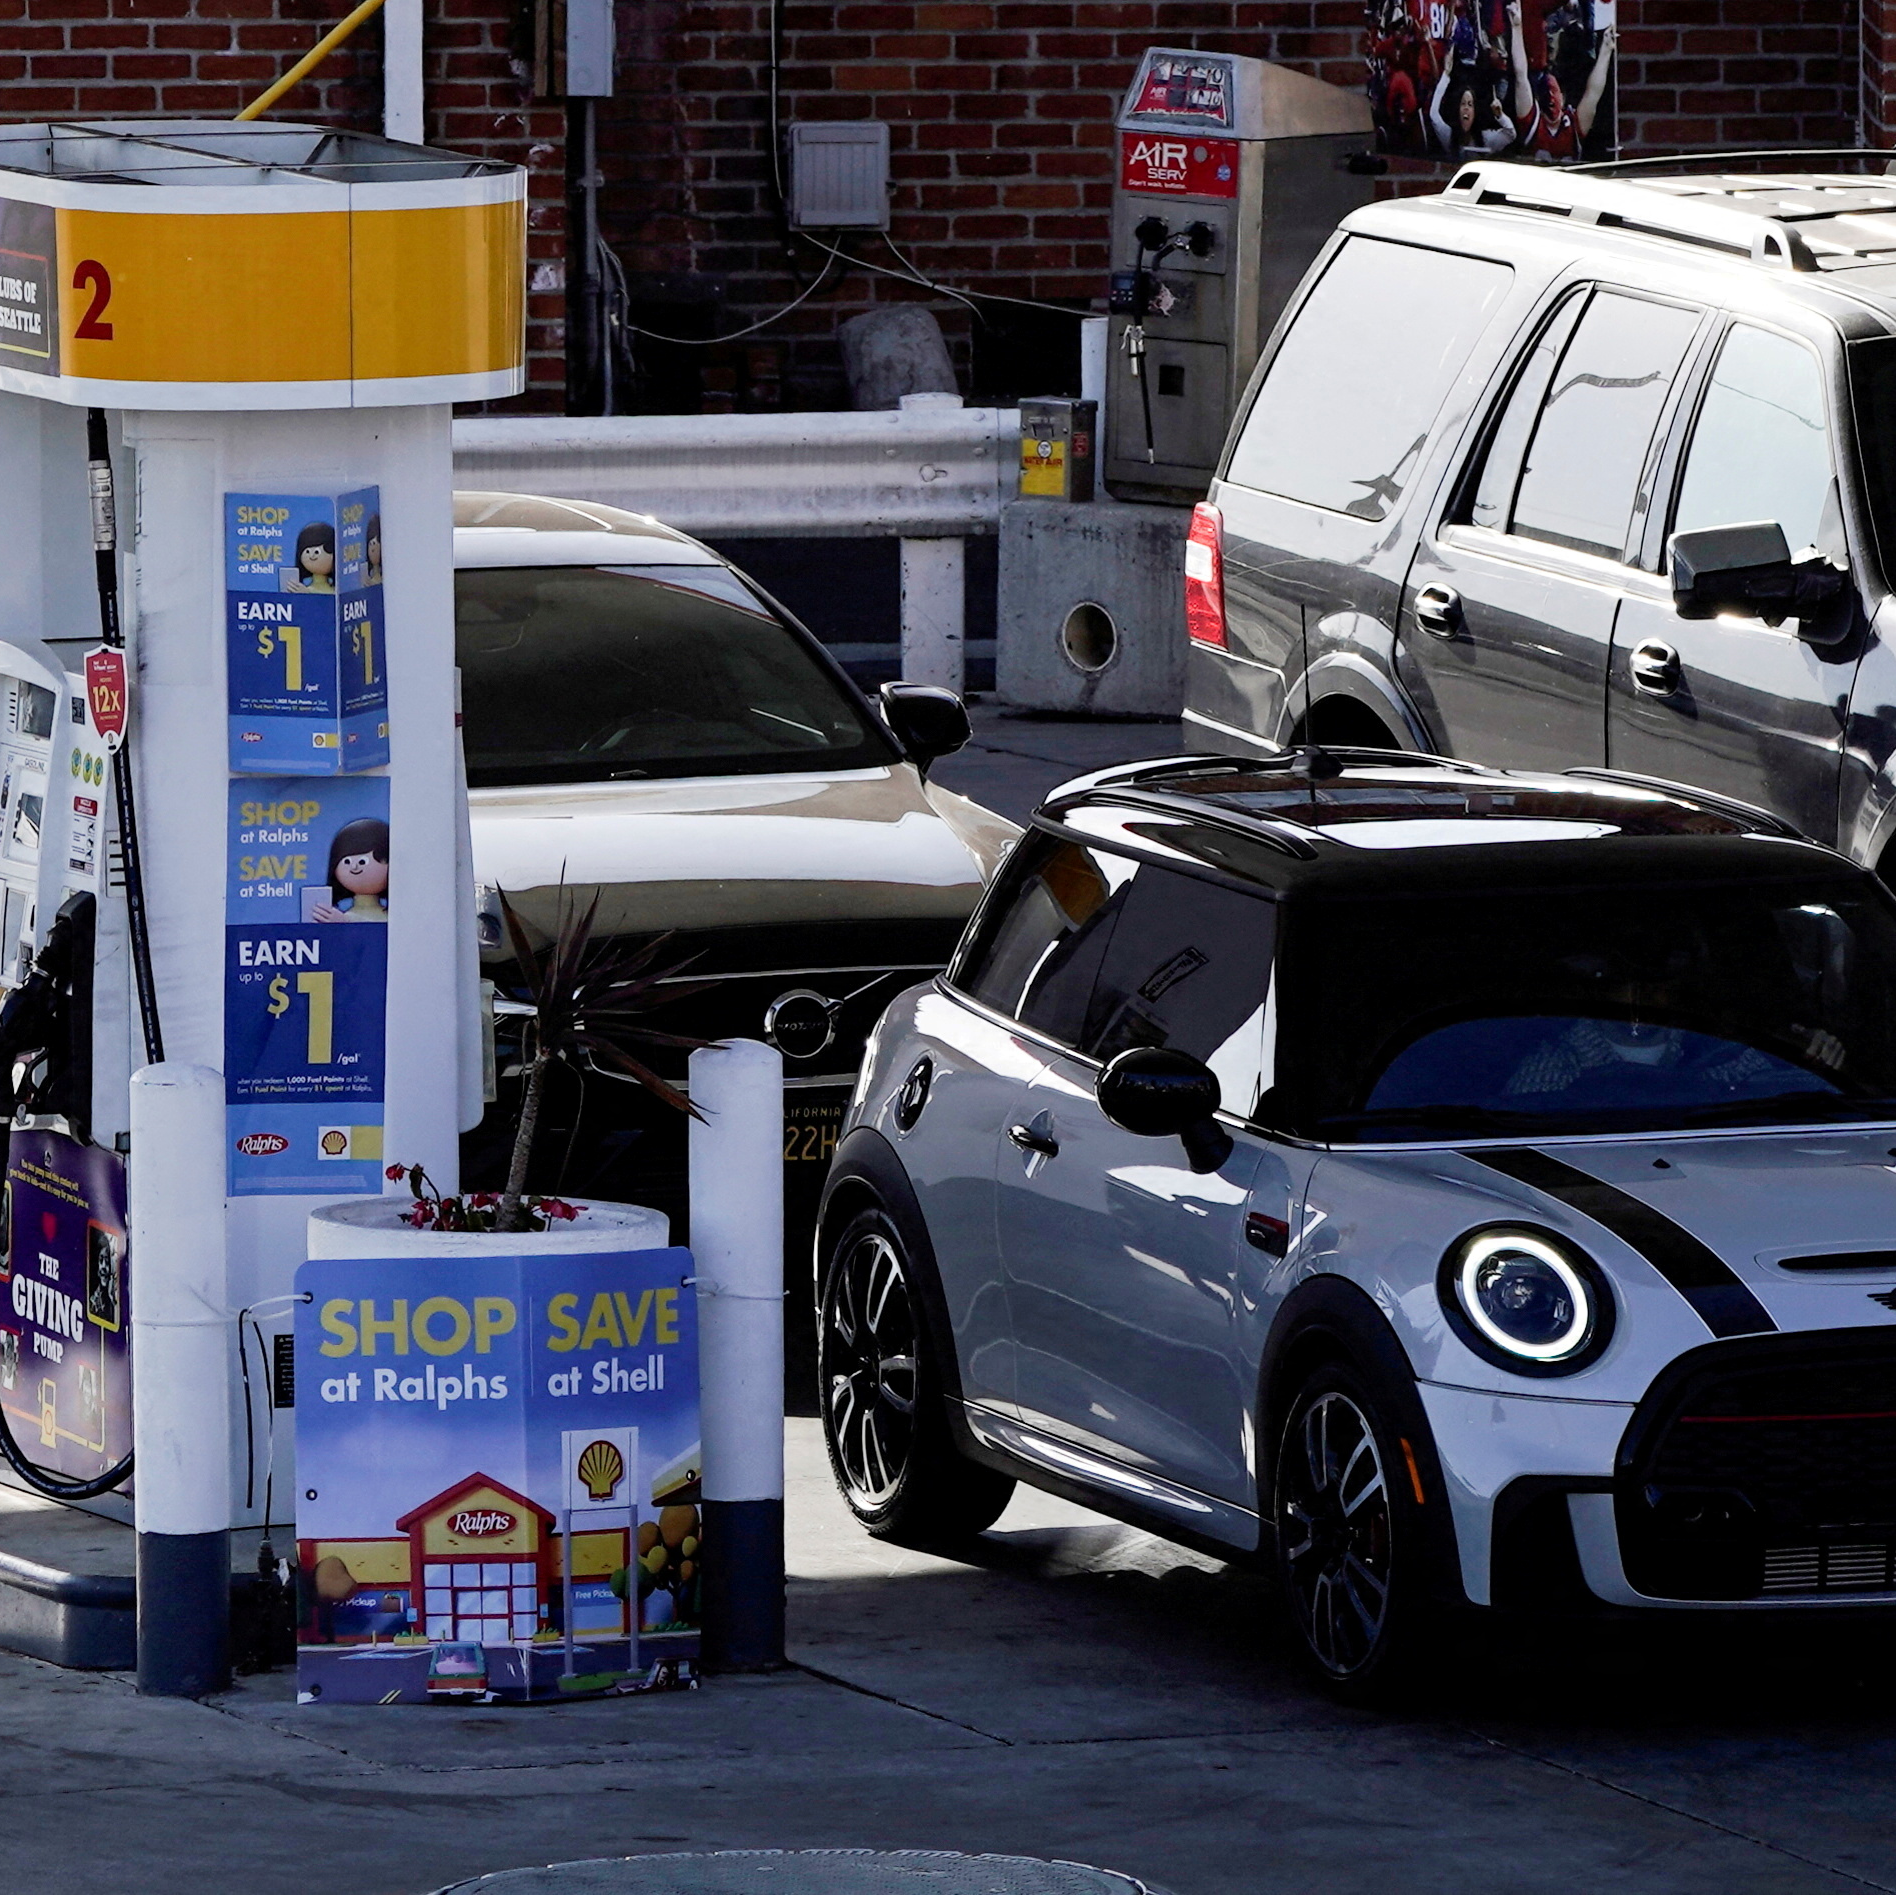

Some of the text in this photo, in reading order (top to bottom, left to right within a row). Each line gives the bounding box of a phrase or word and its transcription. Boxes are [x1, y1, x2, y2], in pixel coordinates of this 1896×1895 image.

[1128, 140, 1188, 170] AIR
[1148, 167, 1187, 181] SERV
[23, 282, 37, 304] OF
[72, 259, 114, 341] 2
[237, 506, 290, 525] SHOP
[237, 526, 283, 539] at Ralphs
[237, 544, 283, 562] SAVE
[238, 563, 274, 574] at Shell
[237, 601, 292, 622] EARN
[343, 600, 367, 622] EARN
[257, 625, 302, 691] $1
[240, 800, 322, 827] SHOP
[240, 828, 309, 846] at Ralphs
[238, 855, 308, 881] SAVE
[239, 882, 293, 898] at Shell
[238, 939, 320, 967] EARN
[239, 972, 264, 984] up to
[267, 971, 334, 1065] $1
[307, 1075, 322, 1084] Fuel
[241, 1135, 284, 1154] Ralphs
[38, 1252, 60, 1282] THE
[11, 1273, 84, 1343] GIVING
[319, 1287, 679, 1358] SHOP SAVE
[33, 1331, 64, 1365] PUMP
[320, 1354, 664, 1410] at Ralphs at Shell
[454, 1511, 511, 1535] Ralphs
